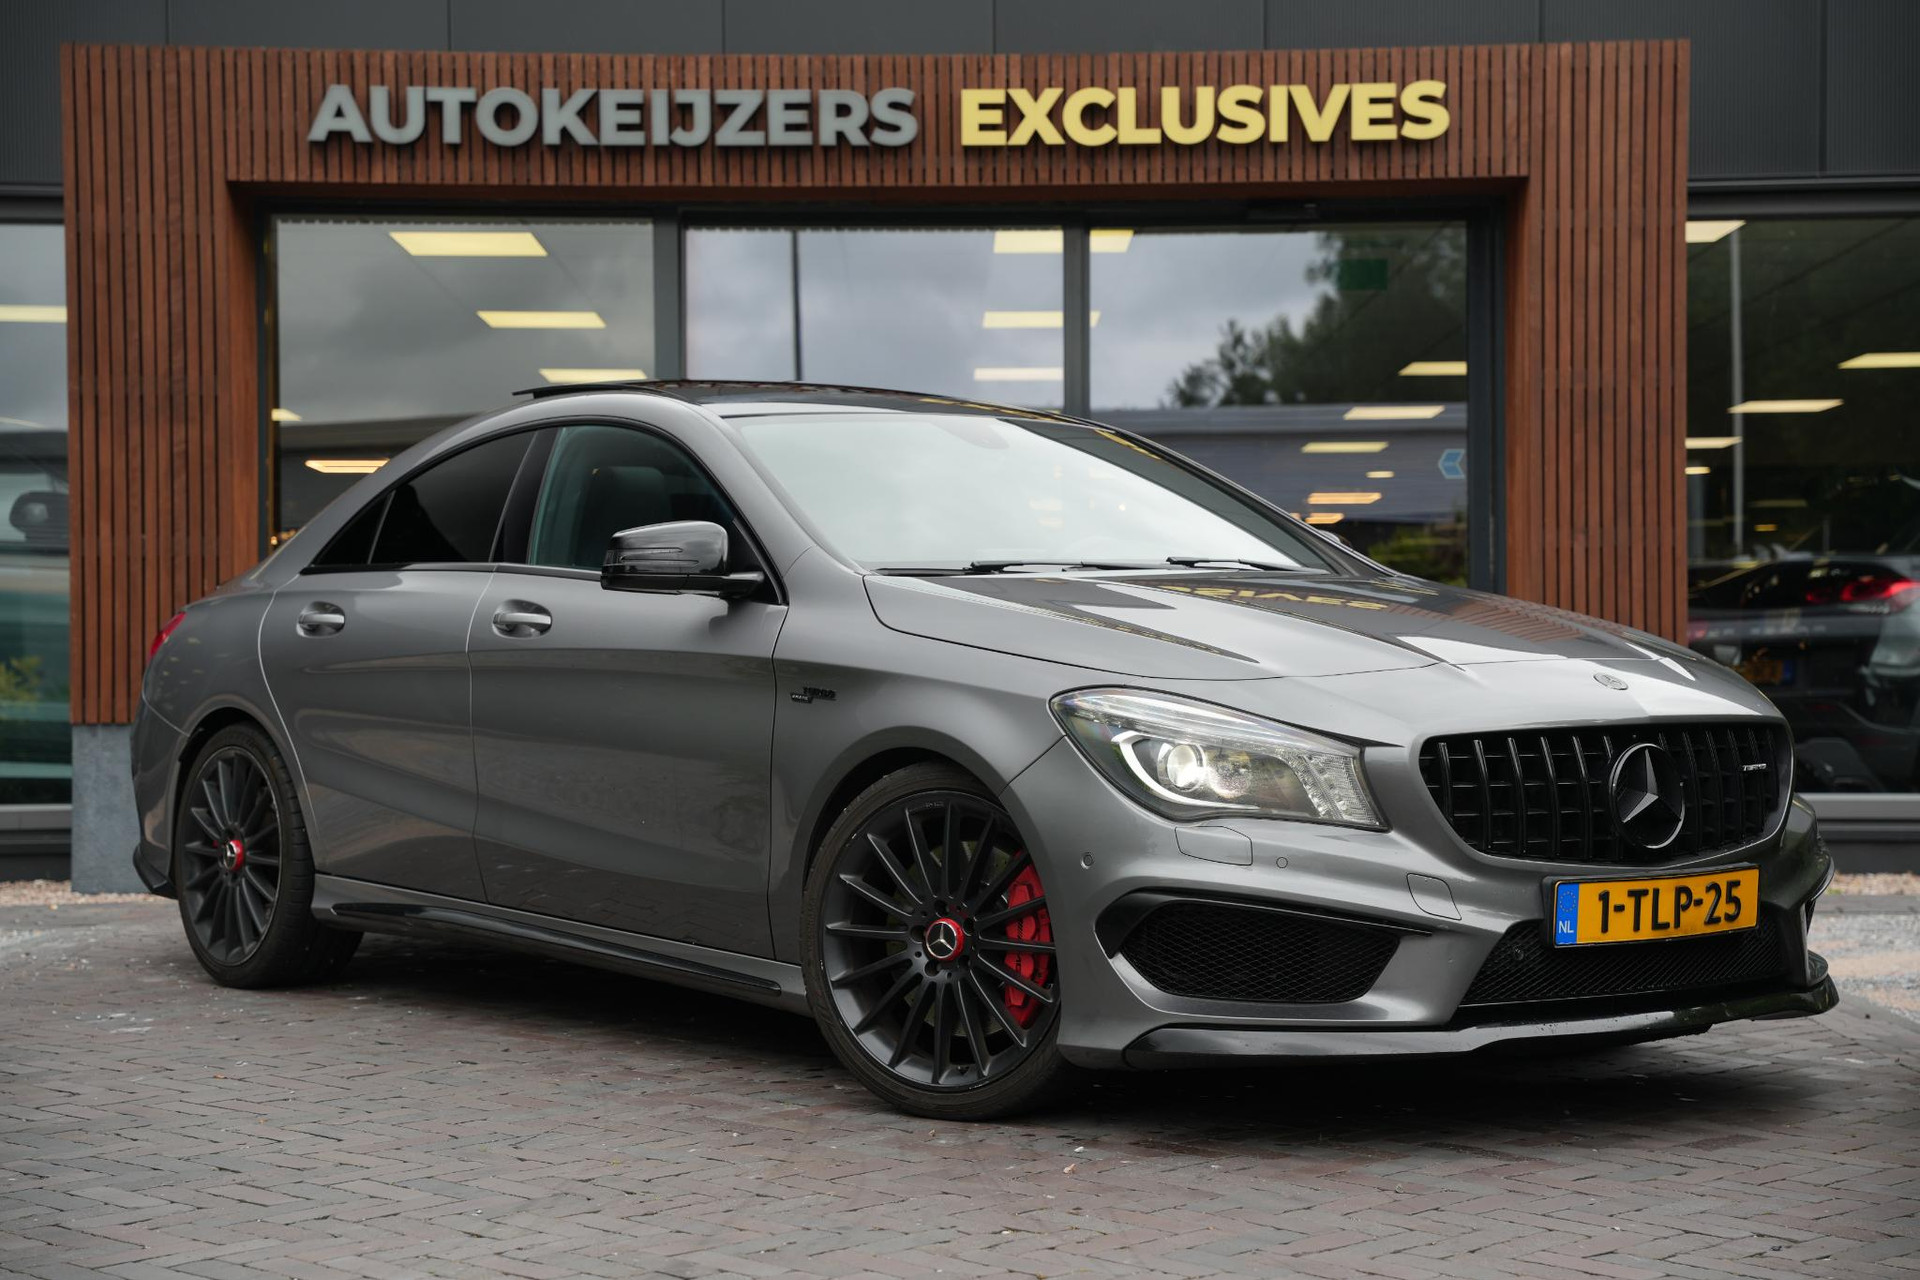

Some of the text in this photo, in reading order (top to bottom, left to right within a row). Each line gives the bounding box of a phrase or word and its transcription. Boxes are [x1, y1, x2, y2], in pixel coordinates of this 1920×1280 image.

[307, 79, 1451, 147] AUTOKEIJZERS EXCLUSIVES
[1558, 920, 1574, 933] NL
[1598, 879, 1742, 933] 1-TLP-25
